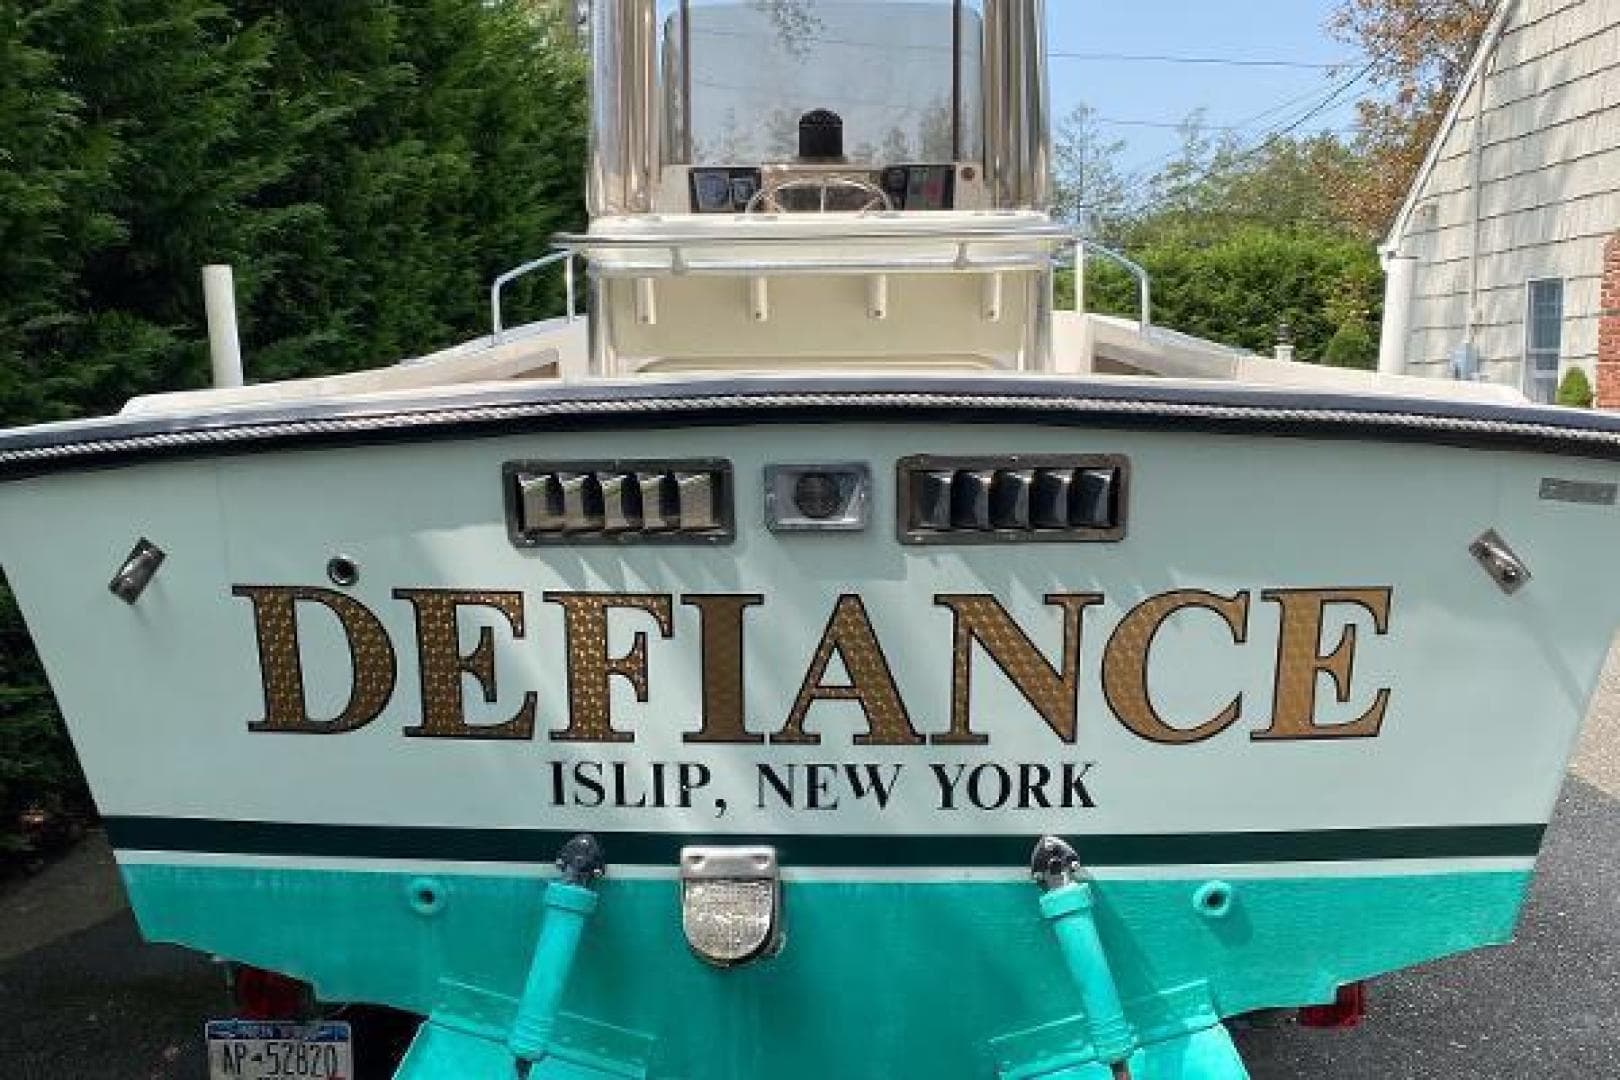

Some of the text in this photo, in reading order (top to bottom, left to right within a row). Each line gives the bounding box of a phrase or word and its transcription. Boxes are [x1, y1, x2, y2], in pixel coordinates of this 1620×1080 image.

[232, 585, 1393, 745] DEFIANCE
[548, 760, 1097, 819] ISLIP, NEW YORK
